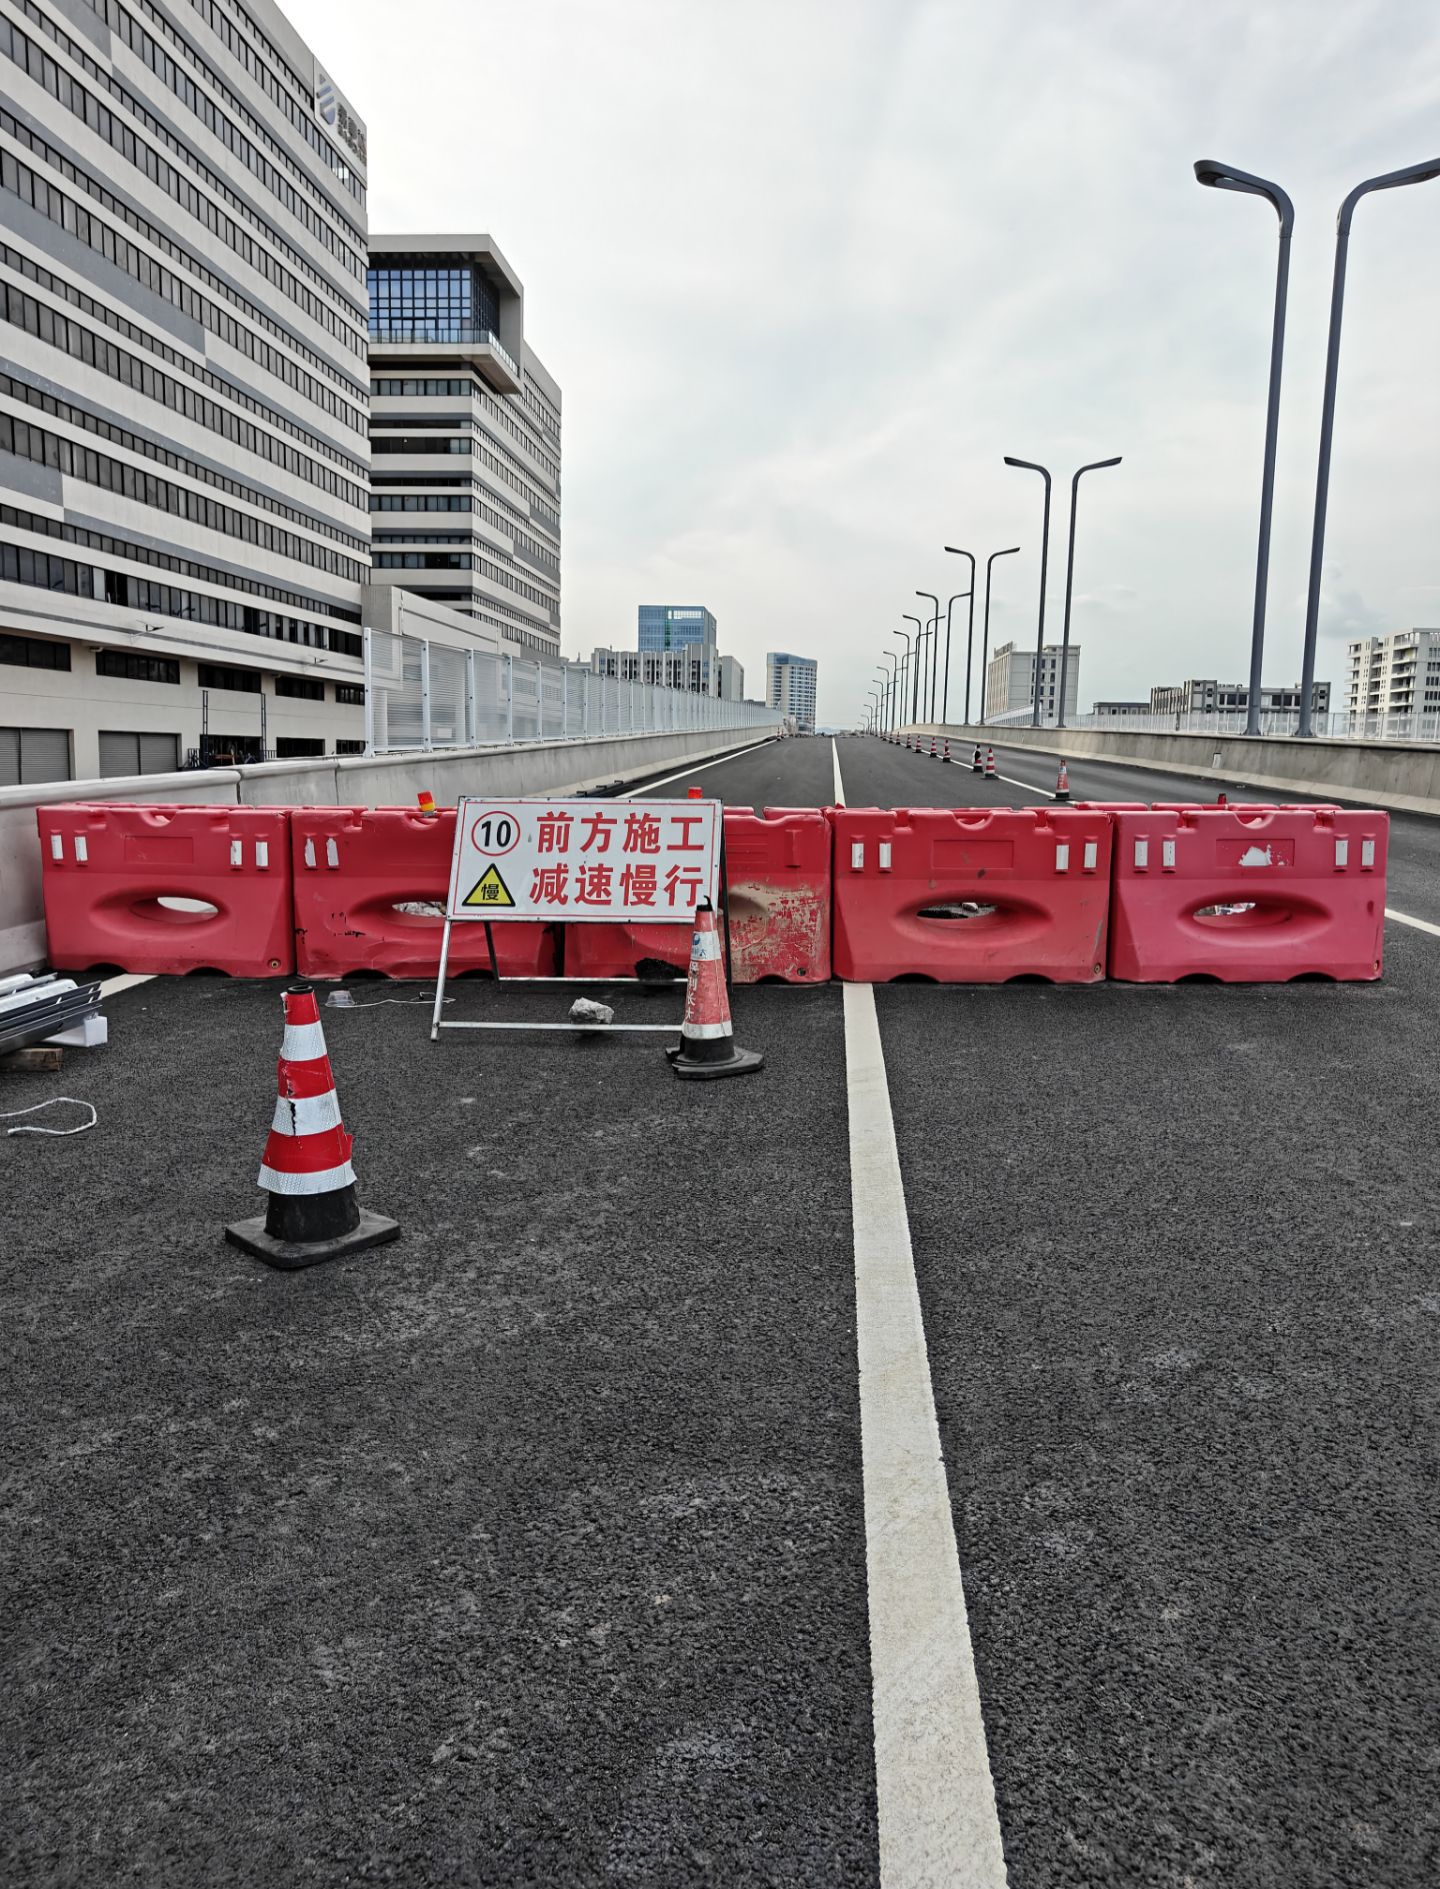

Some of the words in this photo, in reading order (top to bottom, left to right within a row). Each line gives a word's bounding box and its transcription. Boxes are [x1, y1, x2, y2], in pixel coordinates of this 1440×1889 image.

[481, 820, 511, 848] 10
[537, 811, 705, 854] 前方施工
[480, 883, 500, 901] 慢
[529, 863, 704, 907] 减速慢行
